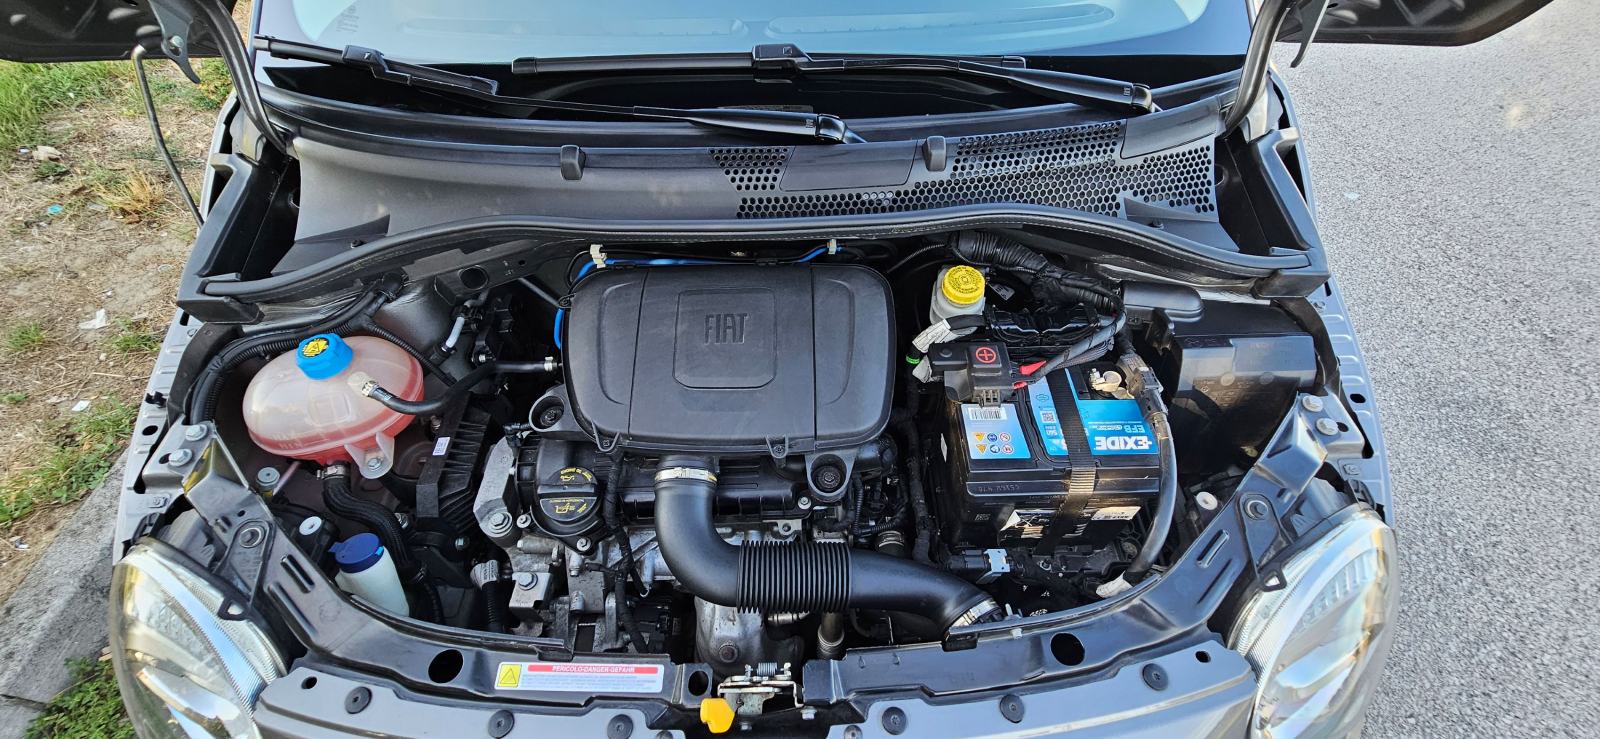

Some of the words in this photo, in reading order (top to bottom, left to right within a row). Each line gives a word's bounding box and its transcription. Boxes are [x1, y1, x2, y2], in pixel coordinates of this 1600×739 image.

[704, 313, 748, 344] FIAT
[1123, 425, 1145, 433] EFB
[1094, 436, 1151, 450] EXIDE
